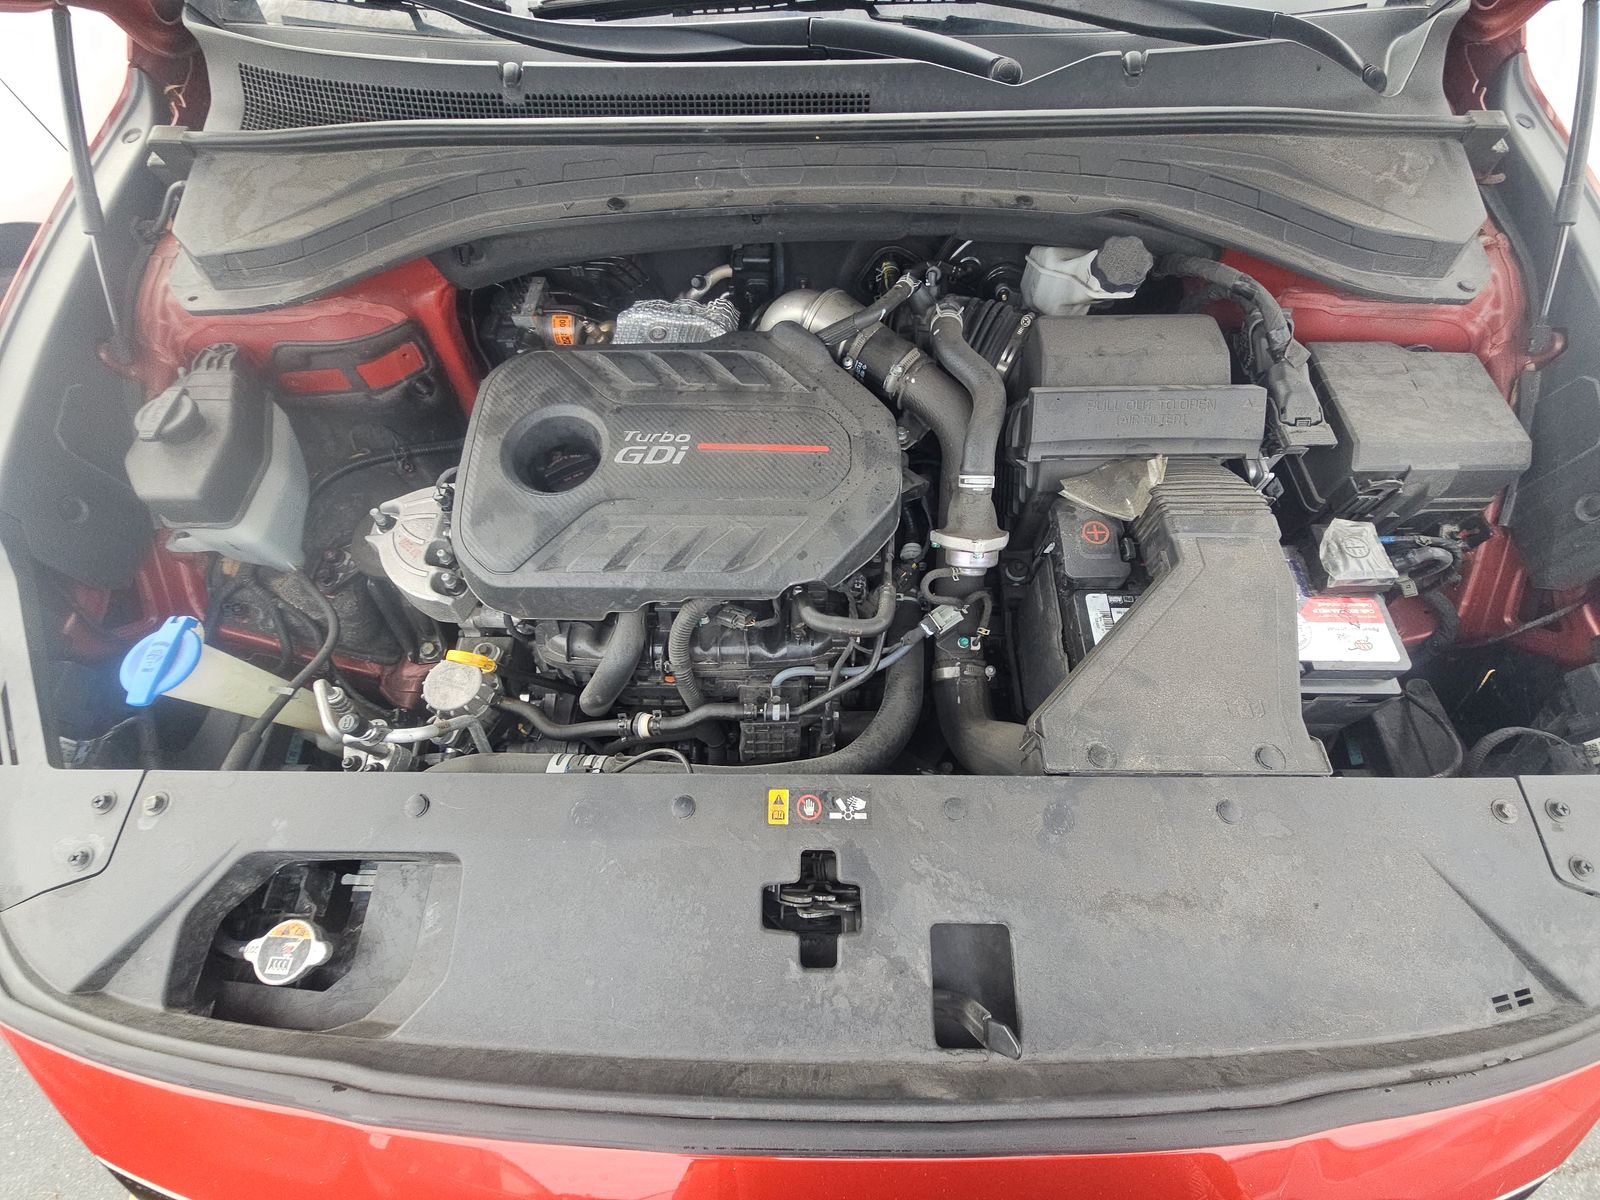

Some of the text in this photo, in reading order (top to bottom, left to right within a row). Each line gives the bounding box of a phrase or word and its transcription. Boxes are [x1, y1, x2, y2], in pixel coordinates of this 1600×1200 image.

[1088, 399, 1216, 412] PULL OUT TO OPEN
[624, 431, 691, 442] Turbo
[614, 445, 689, 464] GDi
